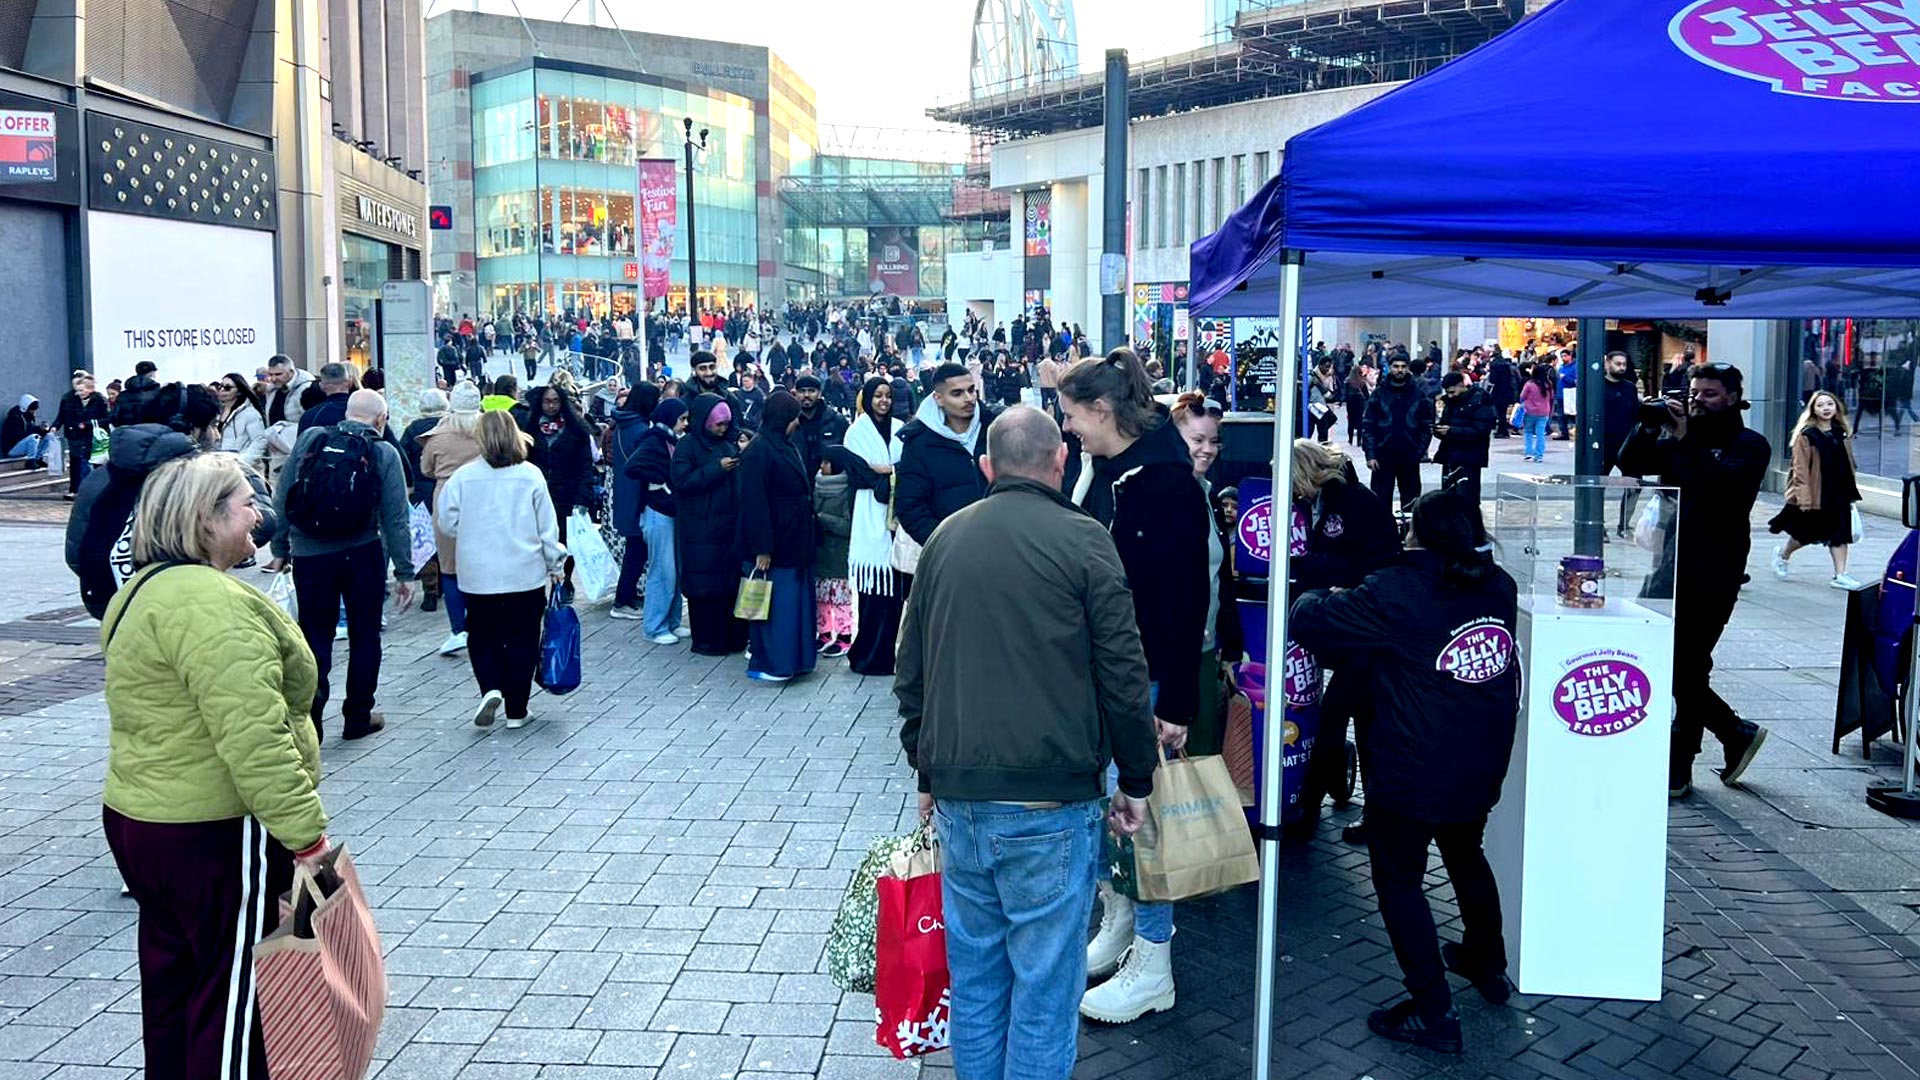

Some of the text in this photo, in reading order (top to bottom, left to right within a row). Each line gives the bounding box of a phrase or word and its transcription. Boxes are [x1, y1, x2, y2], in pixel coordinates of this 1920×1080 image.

[1802, 76, 1920, 97] FAC
[5, 116, 50, 132] OFFER
[9, 166, 50, 176] RAPLEYS
[641, 185, 676, 200] Festive
[355, 194, 417, 238] WATERSTONES
[643, 200, 669, 214] Fun
[123, 328, 256, 350] THIS STORE IS CLOSED
[1465, 631, 1486, 645] THE
[1446, 635, 1499, 670] JELLY
[1565, 648, 1638, 666] Gourmet Jelly Beans
[1583, 665, 1610, 678] THE
[1560, 670, 1627, 703] JELLY
[1573, 687, 1642, 721] BEAN
[1573, 709, 1640, 734] FACTORY
